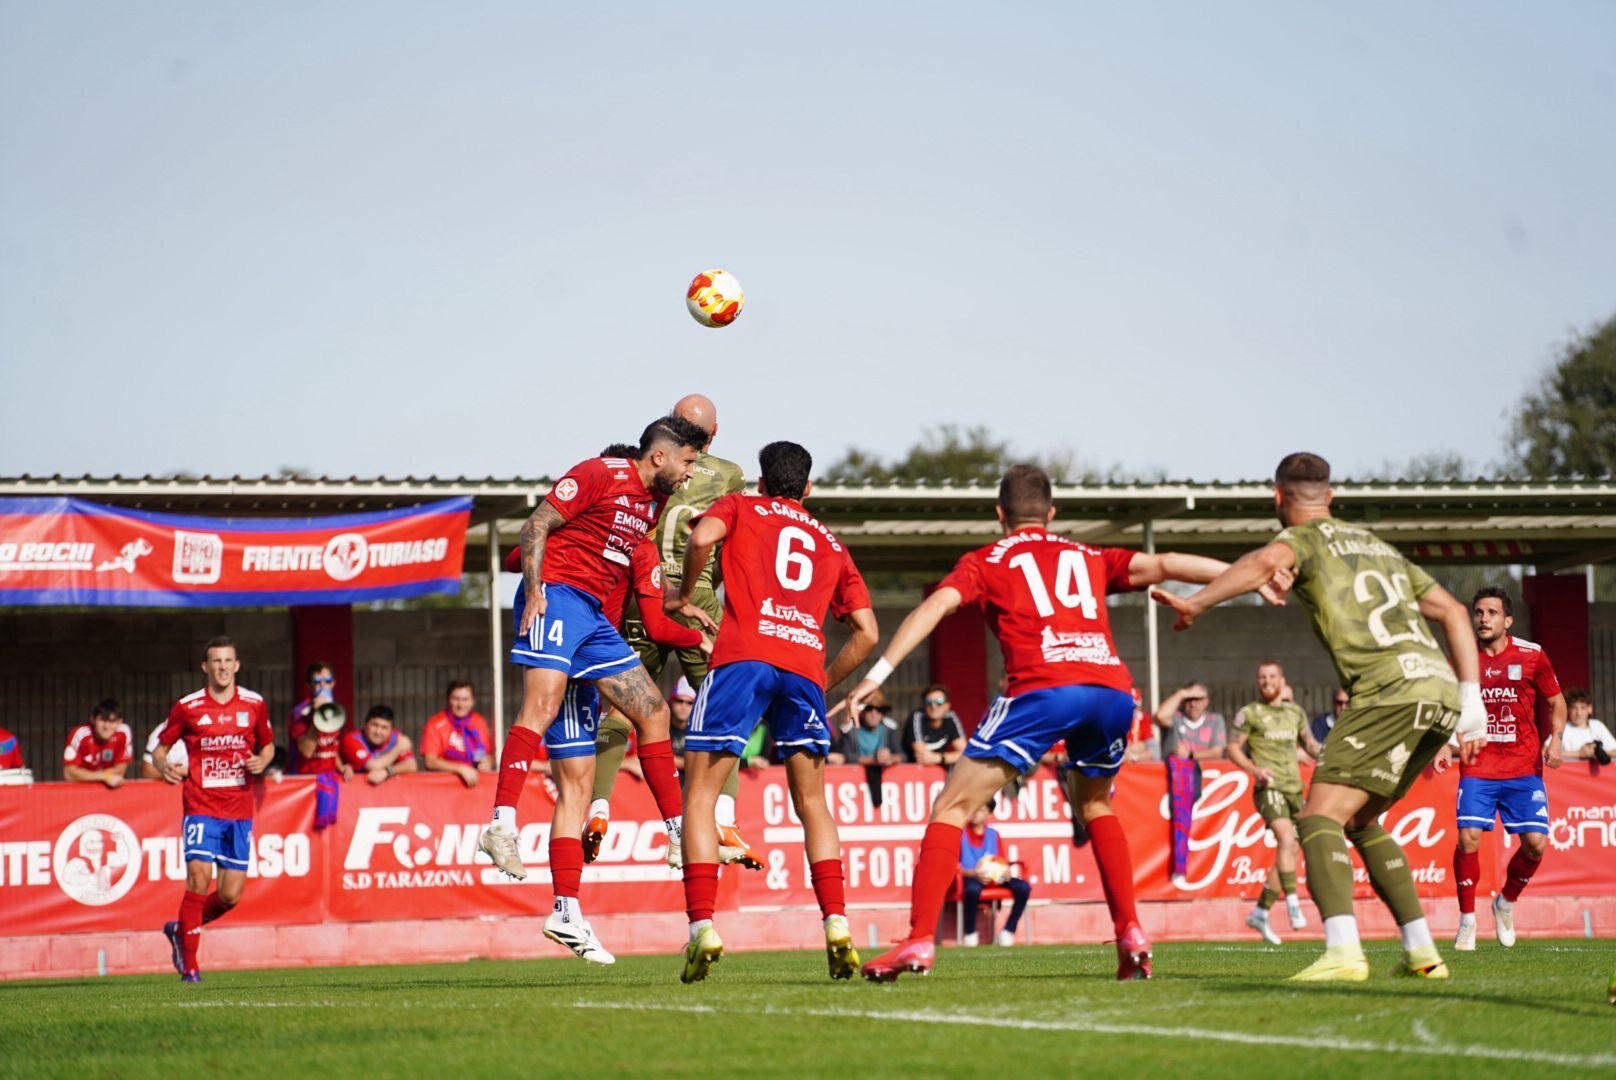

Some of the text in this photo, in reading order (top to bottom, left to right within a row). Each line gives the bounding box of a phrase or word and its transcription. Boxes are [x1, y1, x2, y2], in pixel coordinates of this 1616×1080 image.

[242, 538, 448, 571] FRENTE TURIASO
[776, 526, 816, 591] 6
[1009, 550, 1097, 619] 14
[548, 619, 564, 647] 4
[1480, 687, 1518, 698] MYPAL
[582, 706, 595, 732] 3
[201, 735, 246, 747] EMYPAL
[187, 823, 204, 845] 21
[374, 870, 475, 887] TARAZONA
[766, 849, 789, 890] &
